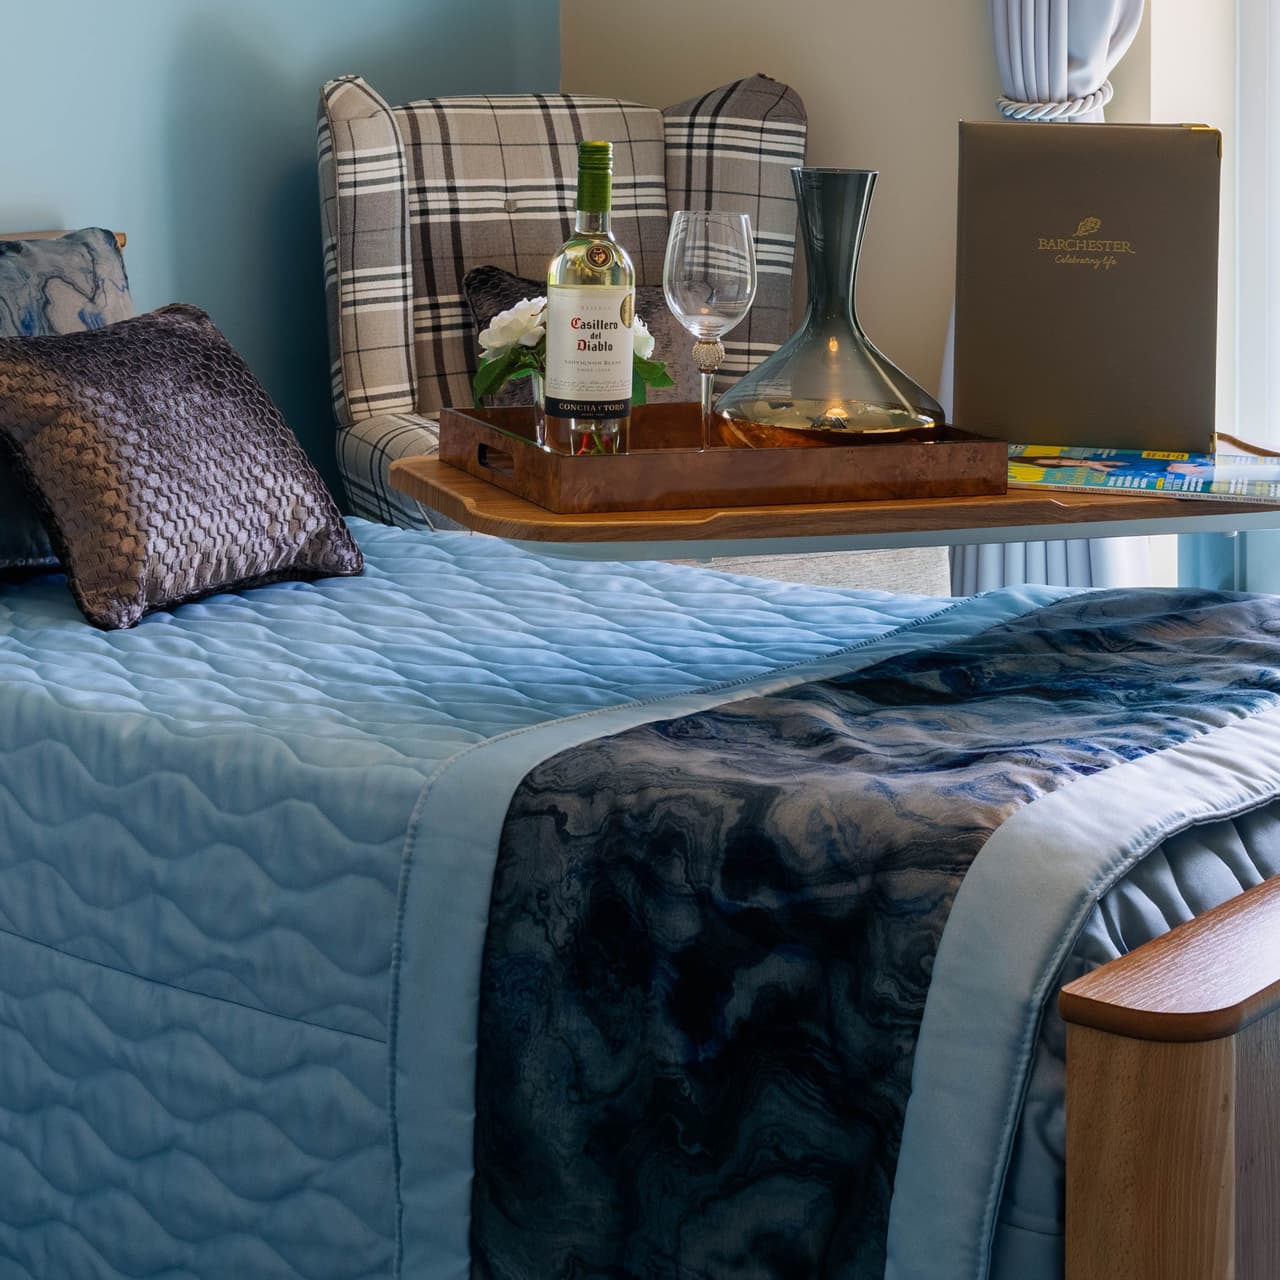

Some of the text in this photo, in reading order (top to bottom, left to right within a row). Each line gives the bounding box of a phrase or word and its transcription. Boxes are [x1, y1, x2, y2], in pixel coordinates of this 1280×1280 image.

[1037, 238, 1136, 254] BARCHESTER
[1055, 255, 1118, 270] Celebrating life
[571, 317, 618, 330] Casillero
[590, 331, 602, 340] del
[577, 339, 613, 351] Diablo
[558, 403, 597, 412] CONCHA
[603, 403, 625, 412] TORO
